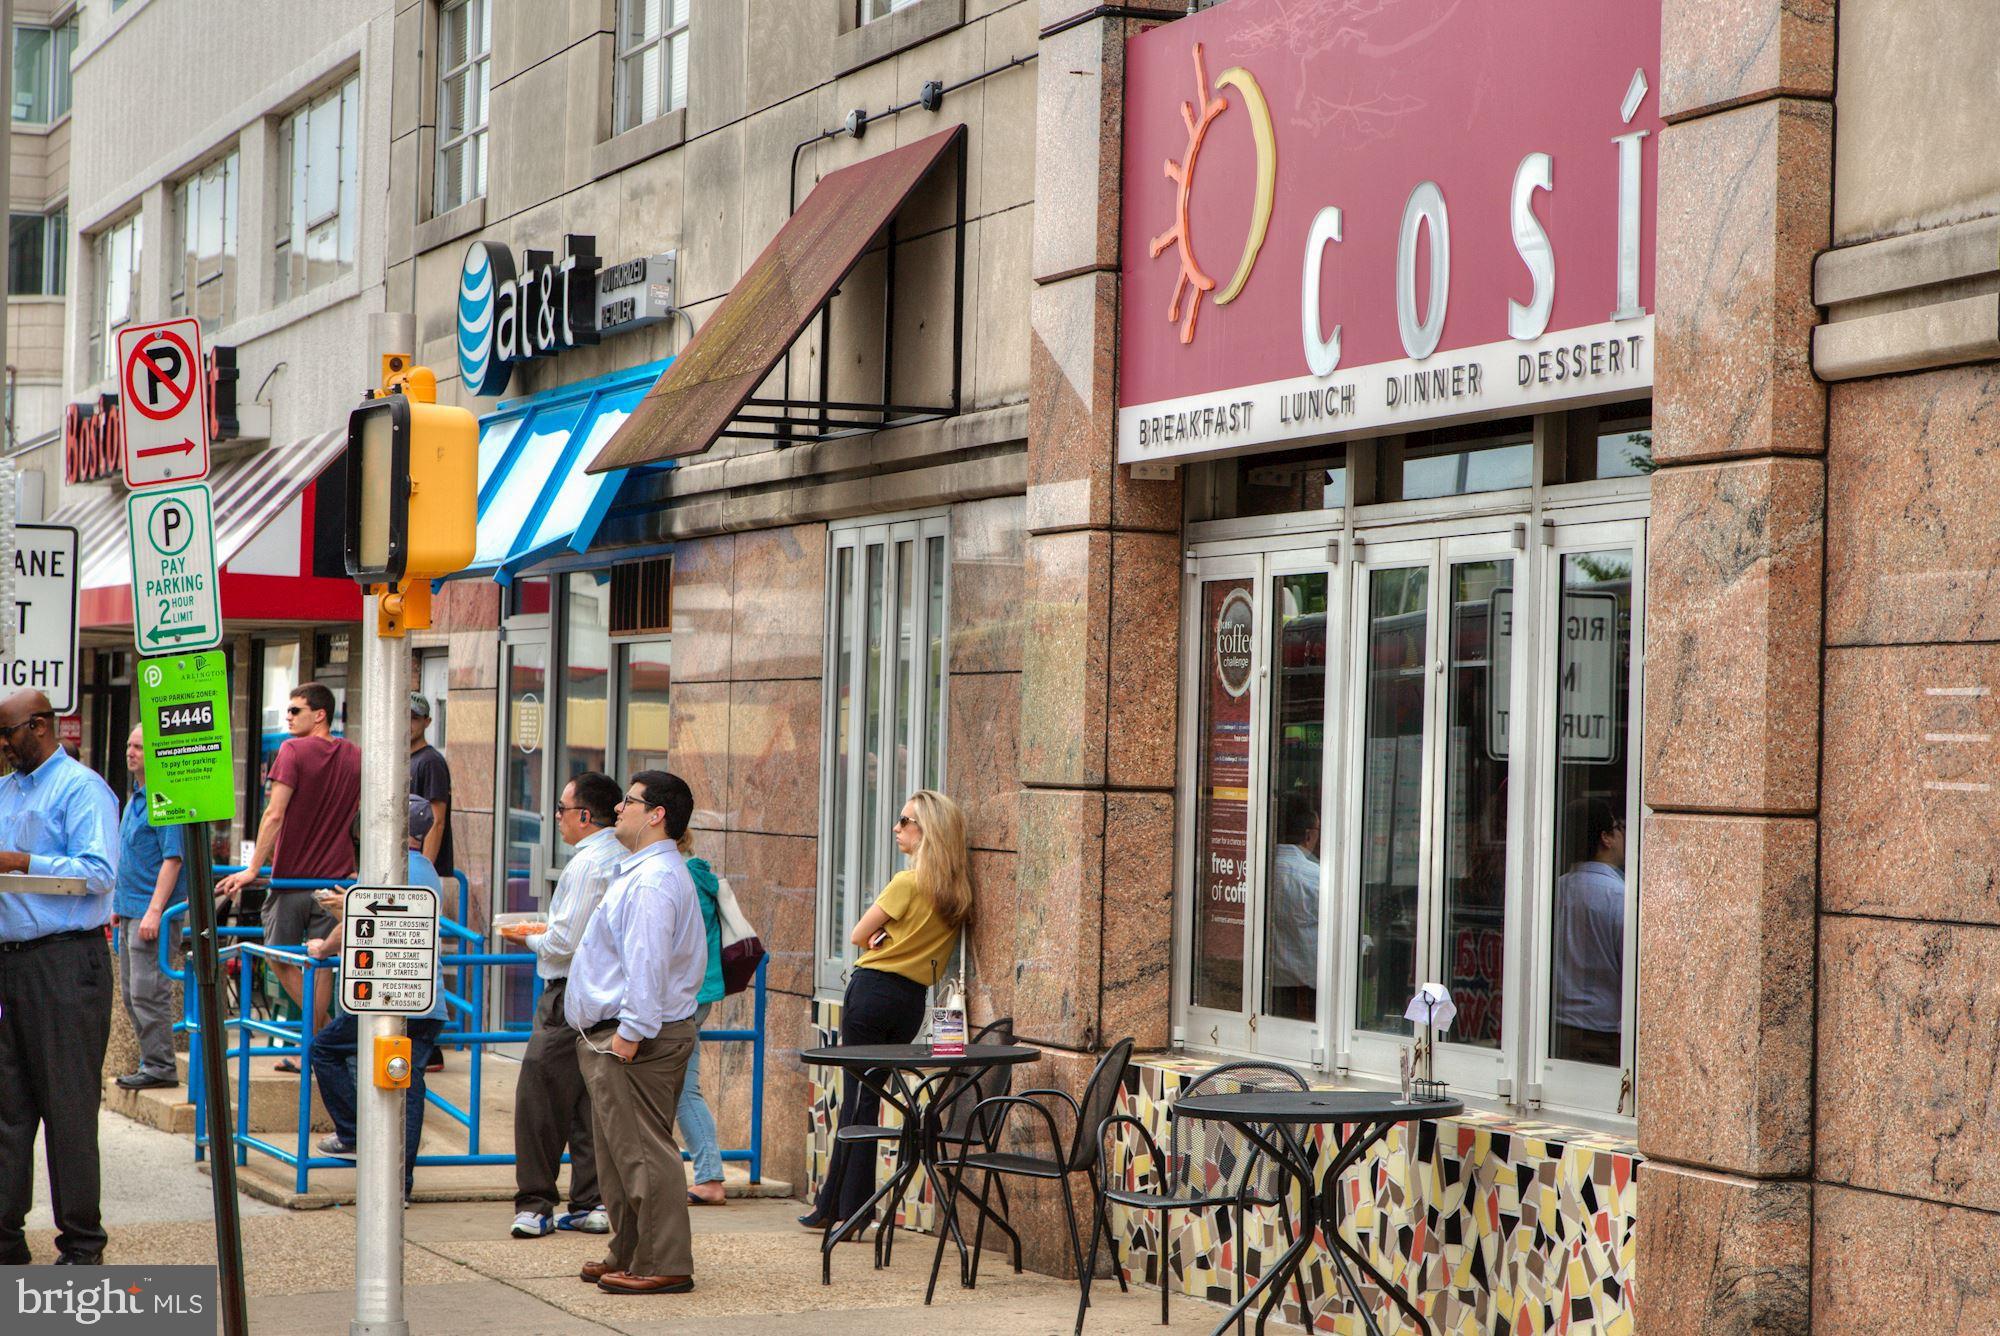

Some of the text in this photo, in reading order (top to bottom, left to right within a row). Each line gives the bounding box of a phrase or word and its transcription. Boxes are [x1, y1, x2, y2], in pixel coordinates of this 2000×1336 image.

[601, 296, 636, 329] RETAILER
[1138, 335, 1642, 445] BREAKFAST LUNCH DINNER DESSERT
[15, 550, 65, 577] ANE
[161, 557, 186, 576] PAY
[146, 574, 204, 597] PARKING
[172, 596, 194, 608] HOUR
[159, 599, 171, 625] 2
[173, 611, 193, 623] LIMIT
[1223, 656, 1248, 668] challenge
[3, 659, 64, 687] IGHT
[181, 670, 225, 680] ARLINGTON
[151, 695, 168, 703] YOUR
[169, 692, 195, 701] PARKING
[161, 706, 212, 728] 54446
[157, 743, 220, 756] www.parkmobile.com
[169, 760, 180, 769] pay
[1212, 852, 1247, 880] free ye
[1212, 880, 1247, 903] of coff
[382, 982, 422, 990] PEDESTRIANS
[391, 999, 421, 1007] CROSSING
